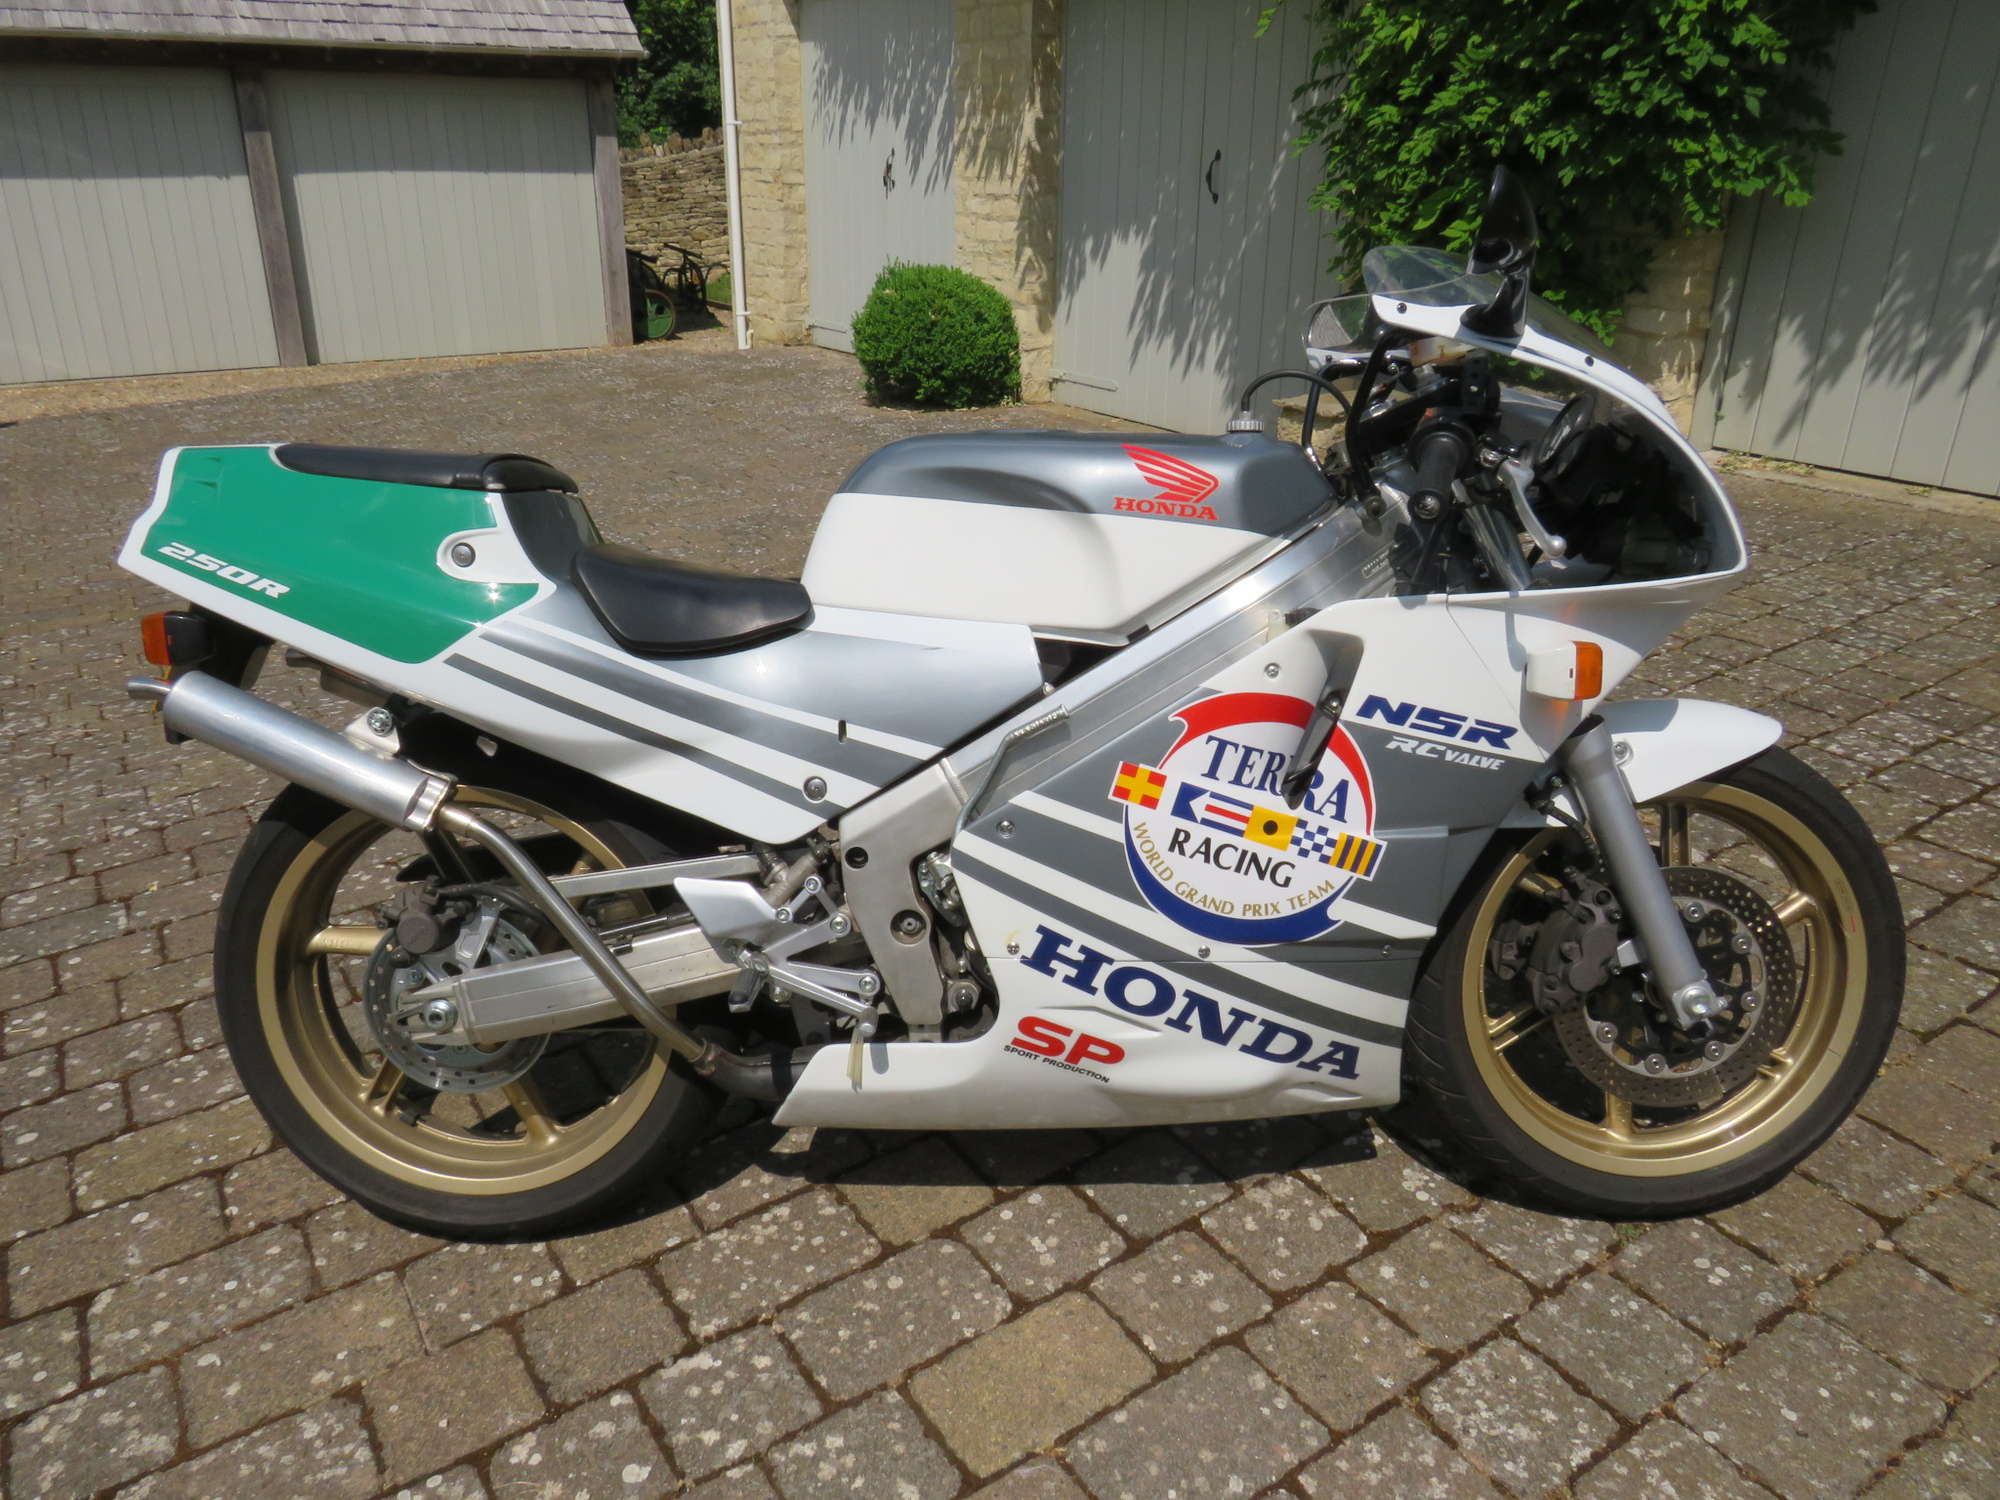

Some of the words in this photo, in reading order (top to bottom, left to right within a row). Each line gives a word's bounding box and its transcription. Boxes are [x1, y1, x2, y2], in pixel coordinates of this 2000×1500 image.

[1113, 497, 1219, 521] HONDA
[157, 541, 291, 599] 250R
[1355, 694, 1519, 750] NSR
[1133, 821, 1175, 882] WORLD
[1174, 880, 1235, 916] GRAND
[1242, 902, 1281, 917] PRIX
[1287, 879, 1336, 911] TEAM
[1167, 827, 1296, 889] RACING
[1020, 924, 1361, 1080] HONDA
[1003, 1044, 1041, 1061] SPORT
[1042, 1056, 1110, 1083] PRODUCTION
[1010, 1015, 1126, 1066] SP
